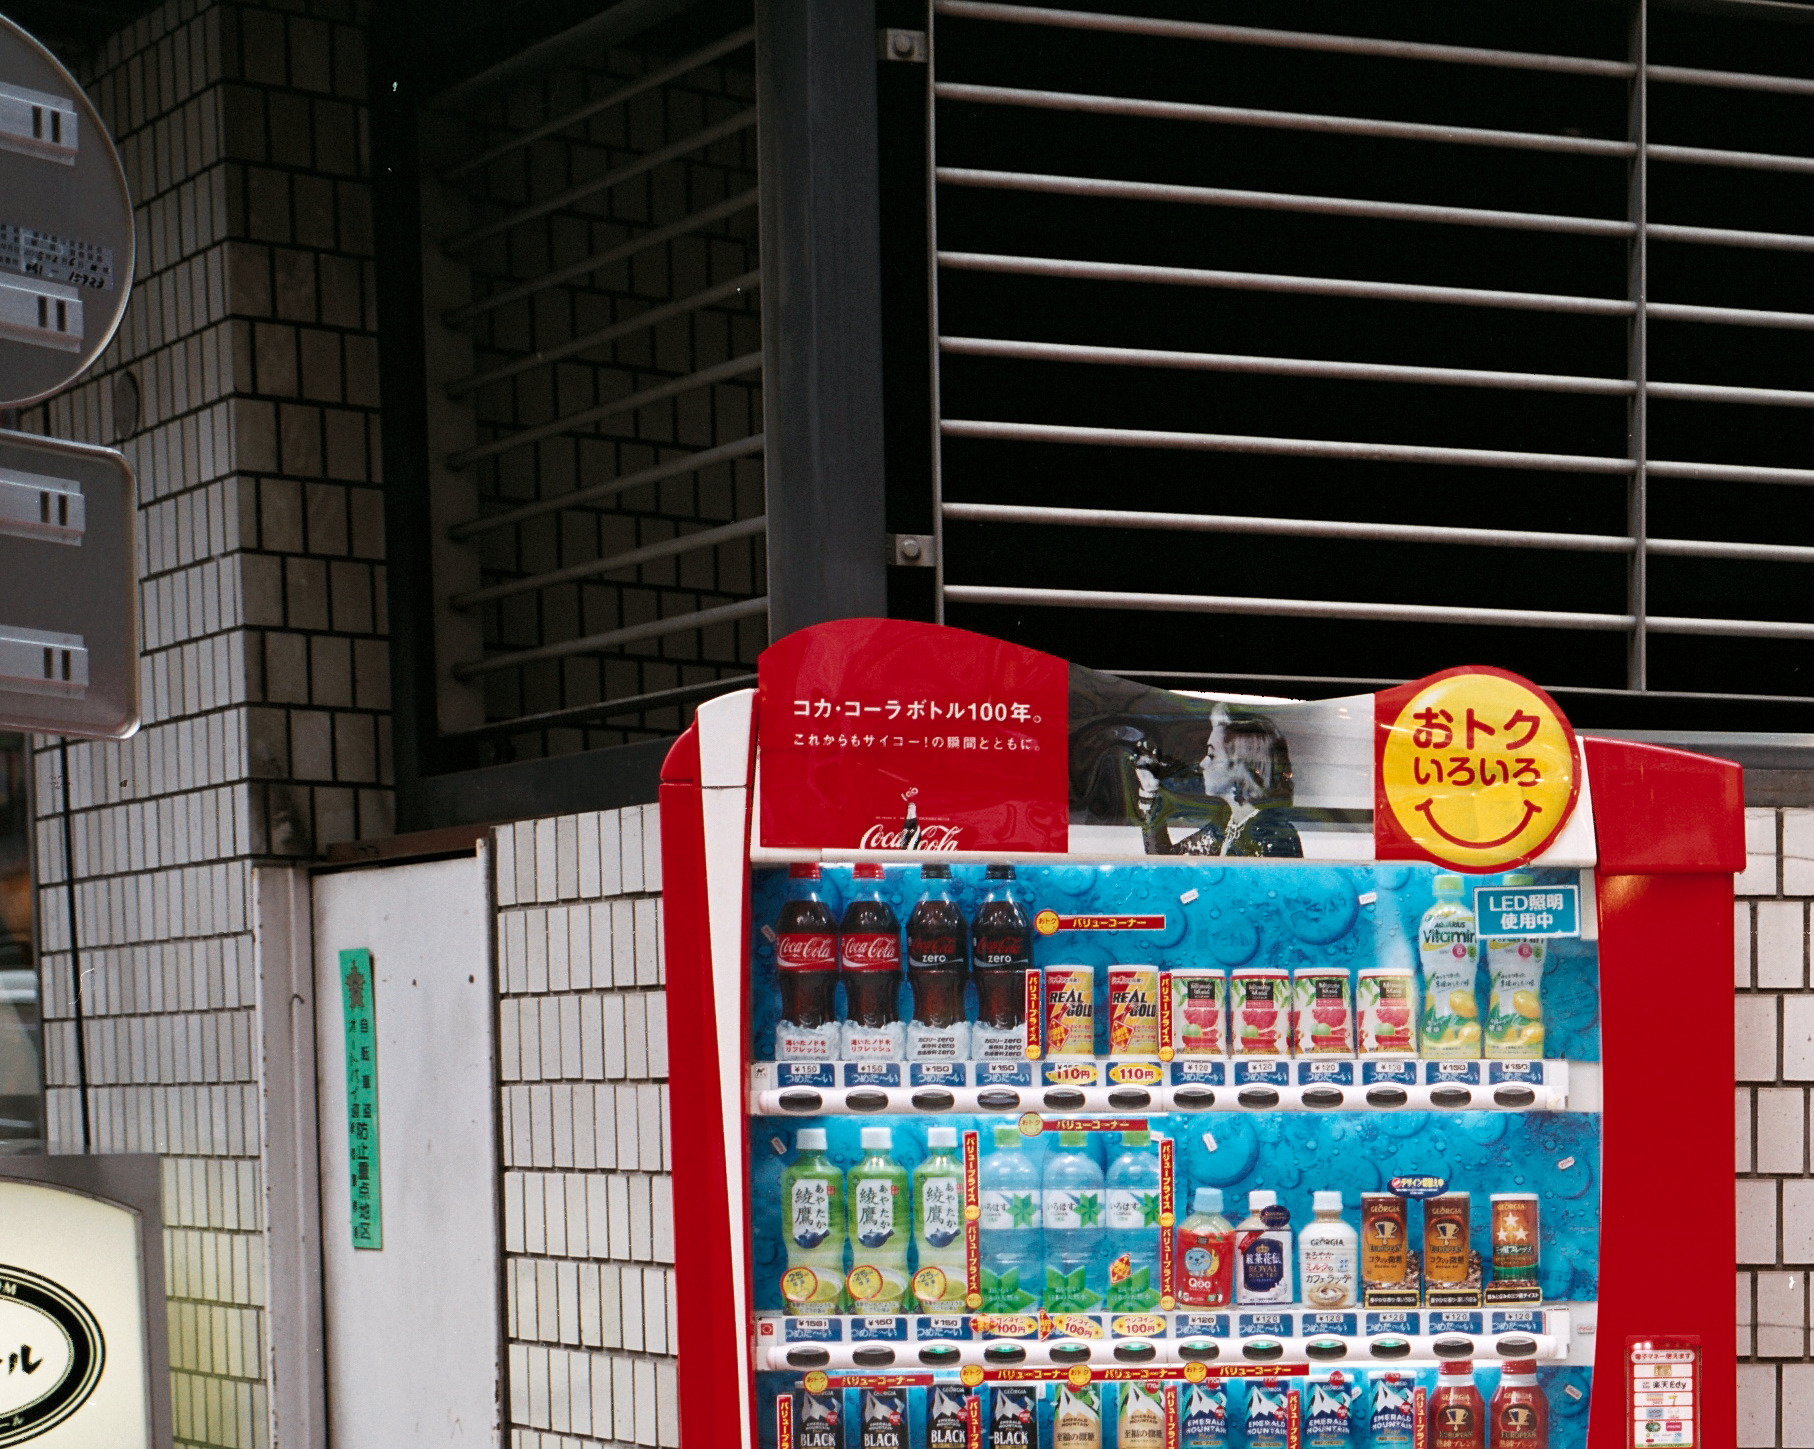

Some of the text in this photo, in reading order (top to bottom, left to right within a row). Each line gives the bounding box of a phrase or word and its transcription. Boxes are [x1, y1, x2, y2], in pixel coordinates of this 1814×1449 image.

[792, 698, 1042, 723] コカ・コーラボトル100年。
[1413, 707, 1541, 751] おトク
[1413, 756, 1541, 788] いろいろ
[1489, 893, 1564, 912] LED照明
[1500, 912, 1554, 930] 使用中
[922, 953, 946, 963] zero
[988, 953, 1012, 963] zero
[1050, 989, 1084, 1005] REAL
[1113, 989, 1147, 1005] REAL
[1065, 1004, 1092, 1018] GOLD
[795, 1065, 818, 1073] ¥150
[1119, 1068, 1154, 1080] 110円
[795, 1187, 816, 1226] 綾鷹
[815, 1183, 827, 1229] あやたか
[858, 1187, 878, 1226] 綾鷹
[878, 1183, 891, 1229] あやたか
[925, 1186, 945, 1225] 綾鷹
[945, 1182, 958, 1229] あやたか
[1245, 1252, 1281, 1265] 紅茶花伝
[1445, 1313, 1467, 1321] ¥120
[1064, 1321, 1093, 1339] 100円
[1126, 1324, 1155, 1334] 100円
[1187, 1419, 1226, 1427] EMERALD
[1248, 1420, 1286, 1428] EMERALD
[1308, 1419, 1348, 1427] EMERALD
[1372, 1422, 1413, 1430] MOUNTAIN
[1373, 1415, 1412, 1423] EMERALD
[931, 1429, 965, 1443] BLACK
[1186, 1426, 1227, 1434] MOUNTAIN
[1247, 1427, 1287, 1436] MOUNTAIN
[1307, 1426, 1349, 1434] MOUNTAIN
[800, 1432, 836, 1446] BLACK
[864, 1432, 899, 1446] BLACK
[994, 1431, 1029, 1445] BLACK
